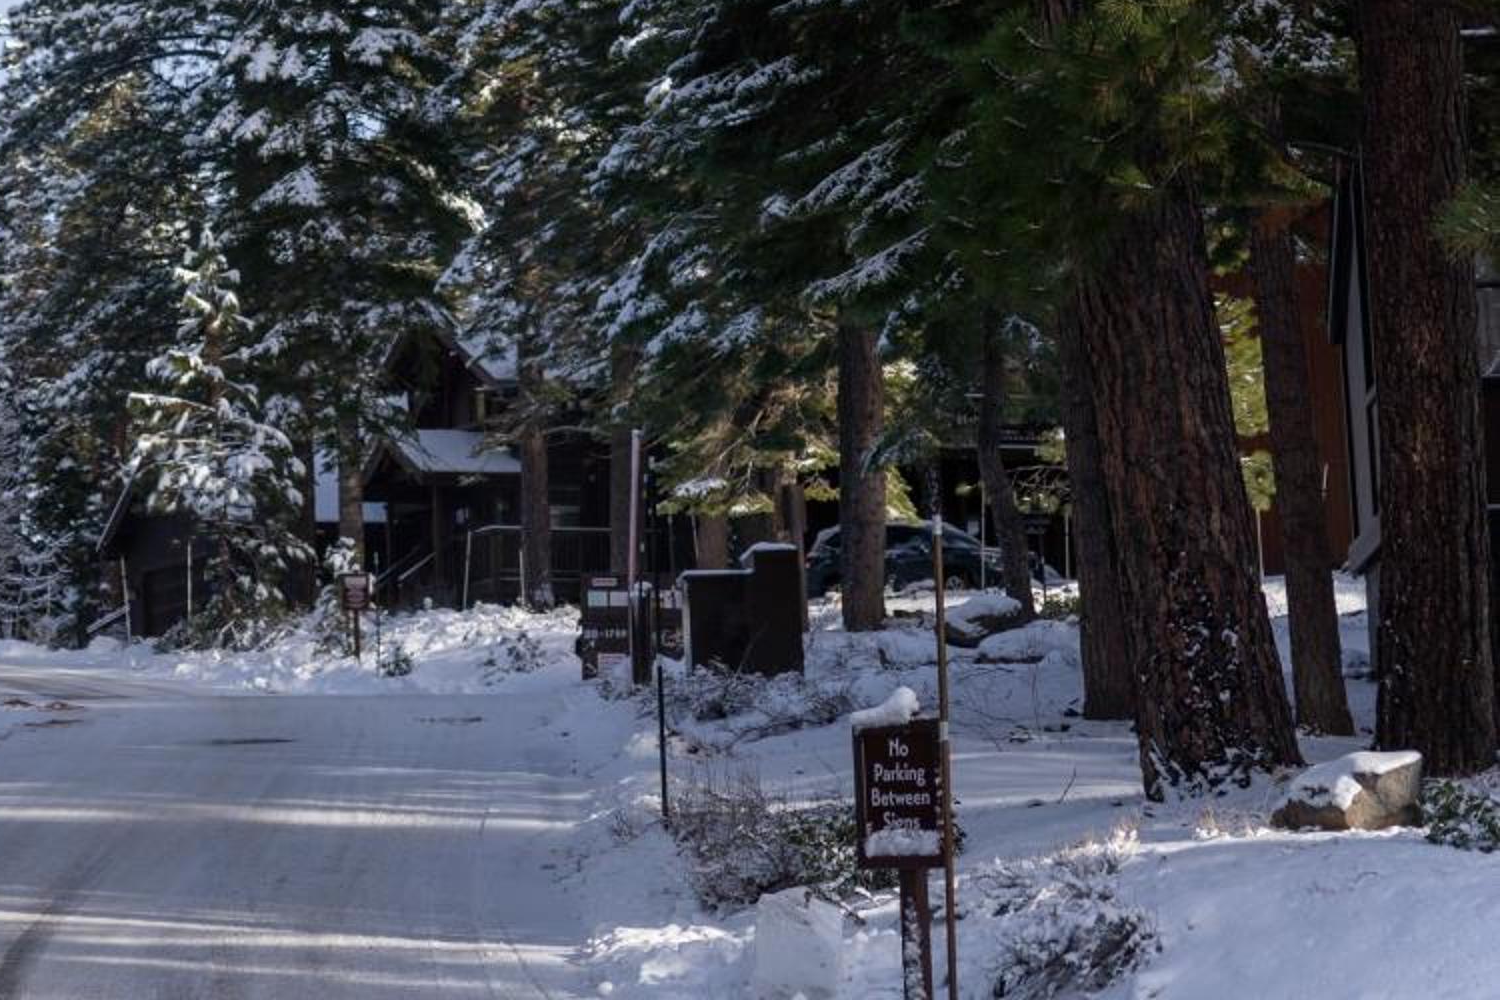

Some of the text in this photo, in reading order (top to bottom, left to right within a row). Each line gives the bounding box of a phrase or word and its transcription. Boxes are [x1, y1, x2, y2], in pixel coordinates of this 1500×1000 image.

[889, 738, 909, 756] No
[874, 762, 925, 787] Parking
[871, 788, 930, 807] Between
